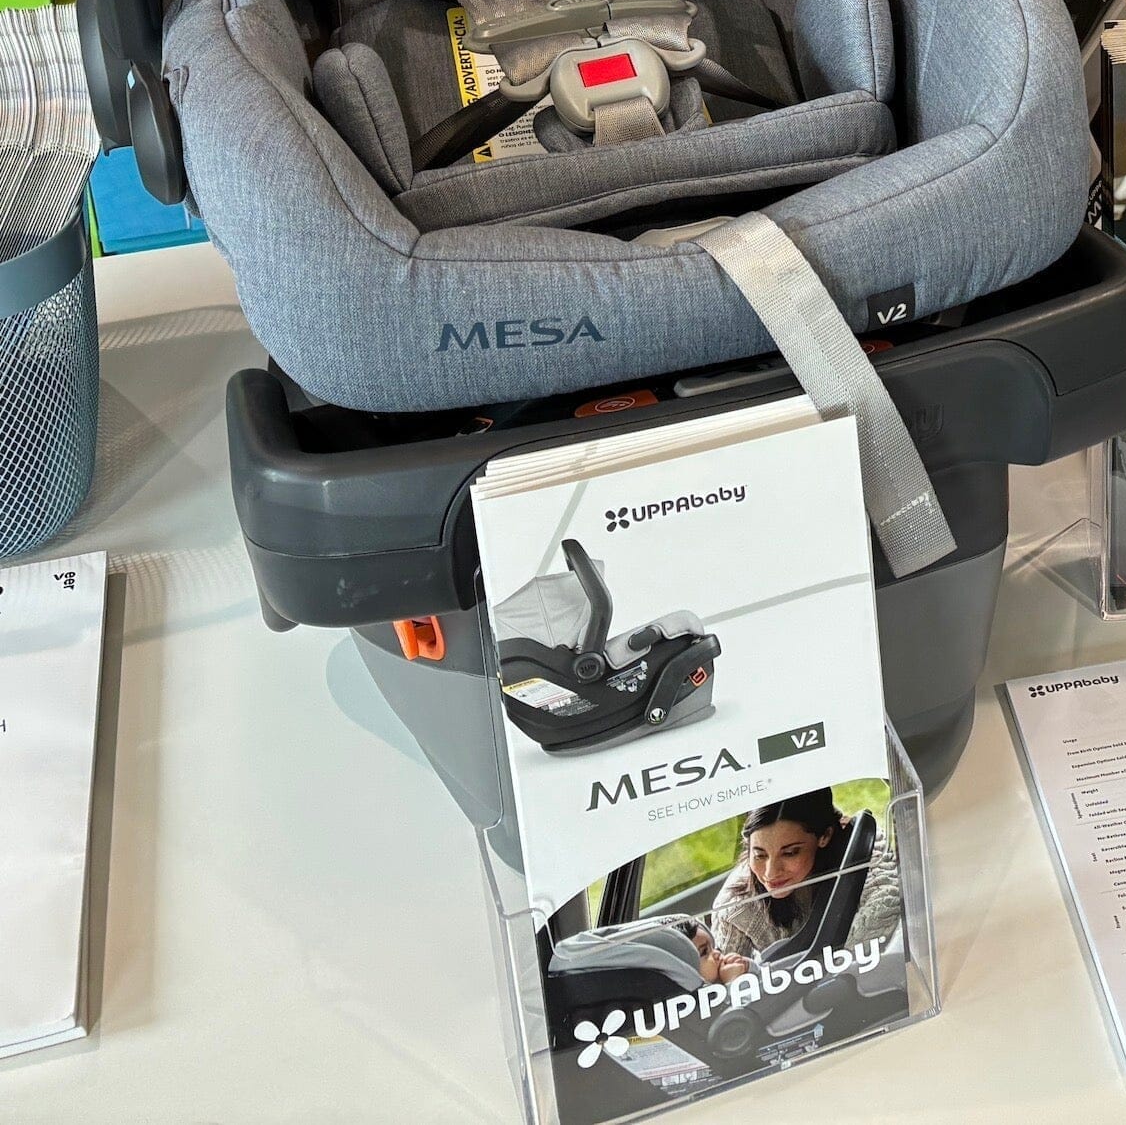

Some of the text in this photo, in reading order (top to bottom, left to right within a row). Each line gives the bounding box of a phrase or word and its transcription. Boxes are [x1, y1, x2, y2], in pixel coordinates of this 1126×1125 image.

[876, 302, 908, 326] V2
[434, 314, 607, 353] MESA
[632, 484, 747, 523] UPPAbaby
[1045, 675, 1120, 694] UPPAbaby
[790, 730, 820, 749] V2
[648, 805, 675, 822] SEE
[678, 793, 713, 814] HOW
[632, 936, 881, 1039] UPPAbaby
